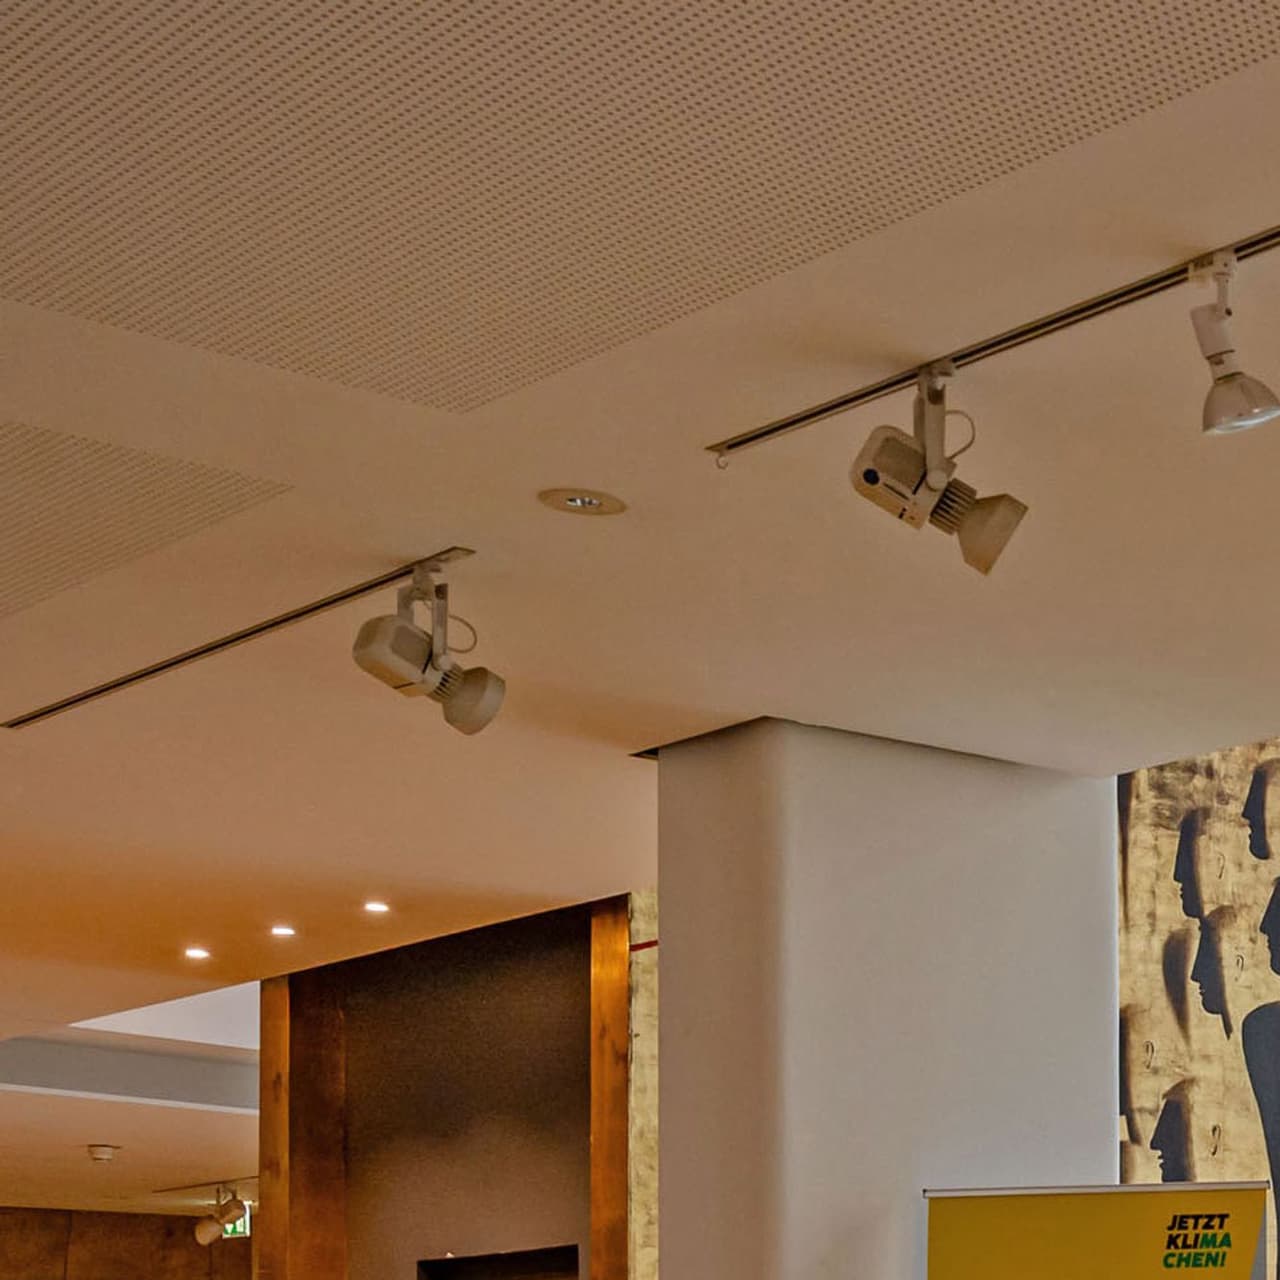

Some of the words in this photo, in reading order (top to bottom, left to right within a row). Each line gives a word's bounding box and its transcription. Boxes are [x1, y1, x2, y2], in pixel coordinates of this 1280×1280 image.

[1166, 1213, 1230, 1232] JETZT
[1165, 1232, 1233, 1250] KLIMA
[1162, 1250, 1227, 1269] CHEN!
